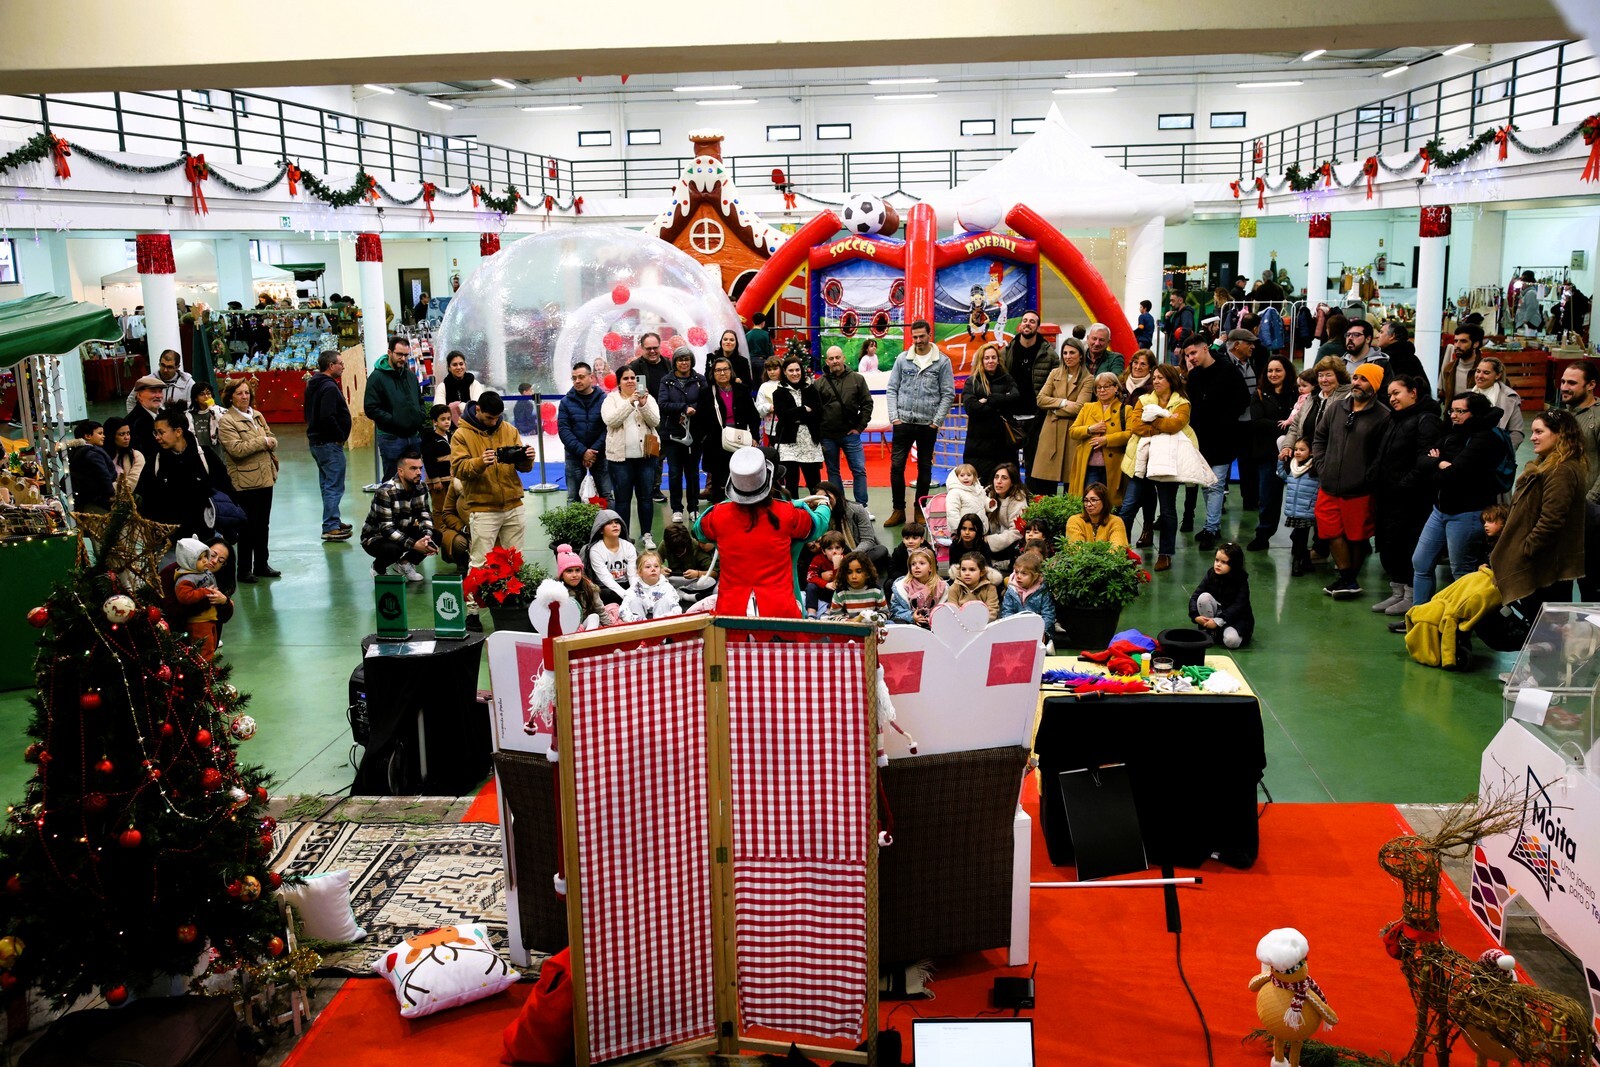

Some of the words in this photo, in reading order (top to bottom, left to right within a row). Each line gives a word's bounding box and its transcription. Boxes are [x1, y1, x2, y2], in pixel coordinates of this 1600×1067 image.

[830, 239, 876, 258] SOCCER
[964, 235, 1017, 255] BASEBALL
[1532, 799, 1577, 863] Moita
[1560, 859, 1575, 880] Uma
[1575, 874, 1596, 900] janela
[1569, 884, 1584, 904] para
[1584, 900, 1590, 910] o
